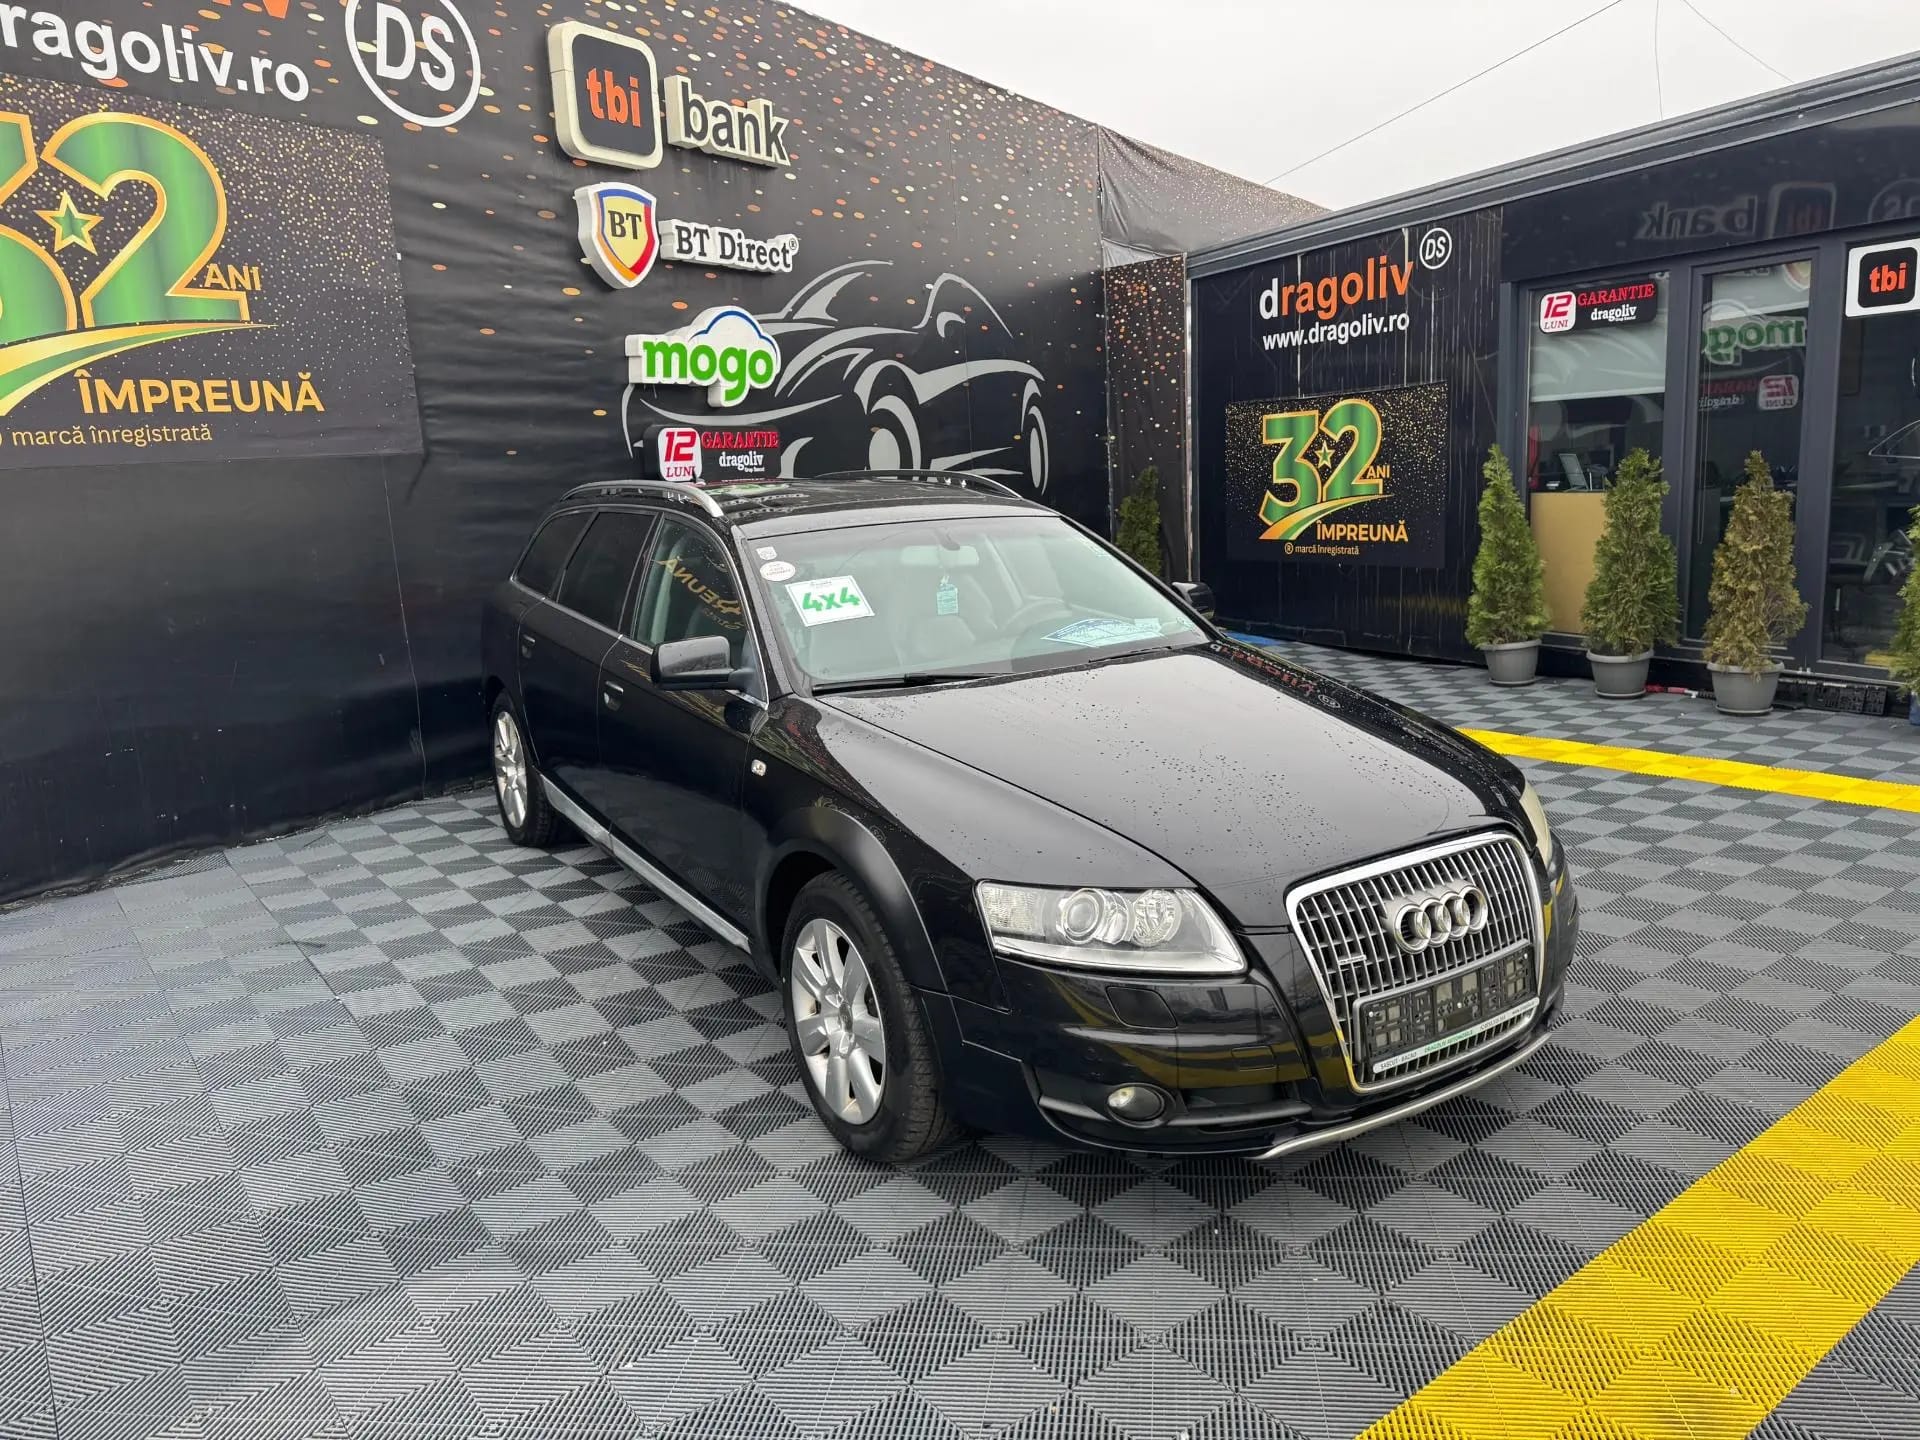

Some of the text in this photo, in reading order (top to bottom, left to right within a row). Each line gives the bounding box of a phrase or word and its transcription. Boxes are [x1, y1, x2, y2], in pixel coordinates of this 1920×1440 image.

[376, 3, 455, 91] DS
[586, 67, 789, 163] tbi bank
[608, 210, 642, 240] BT
[675, 225, 710, 257] BT
[1425, 236, 1447, 261] DS
[203, 263, 262, 291] ANI
[1259, 254, 1415, 320] dragoliv
[1869, 262, 1907, 293] tbi
[1544, 294, 1573, 319] 12
[1577, 283, 1655, 306] GARANTIE
[1543, 319, 1569, 330] LUNI
[1590, 303, 1637, 322] dragoliv
[1262, 313, 1411, 351] www.dragoliv.ro
[642, 340, 775, 402] mogo
[74, 368, 326, 415] ÎMPREUNĂ
[12, 422, 214, 448] marcă înregistrată
[664, 431, 697, 462] 12
[701, 430, 780, 449] GARANTIE
[719, 450, 764, 471] dragoliv
[1258, 398, 1384, 527] 32
[1366, 465, 1390, 480] ANI
[1316, 519, 1409, 543] ÎMPREUNĂ
[1295, 544, 1316, 554] marcă
[1317, 544, 1360, 556] înregistrată
